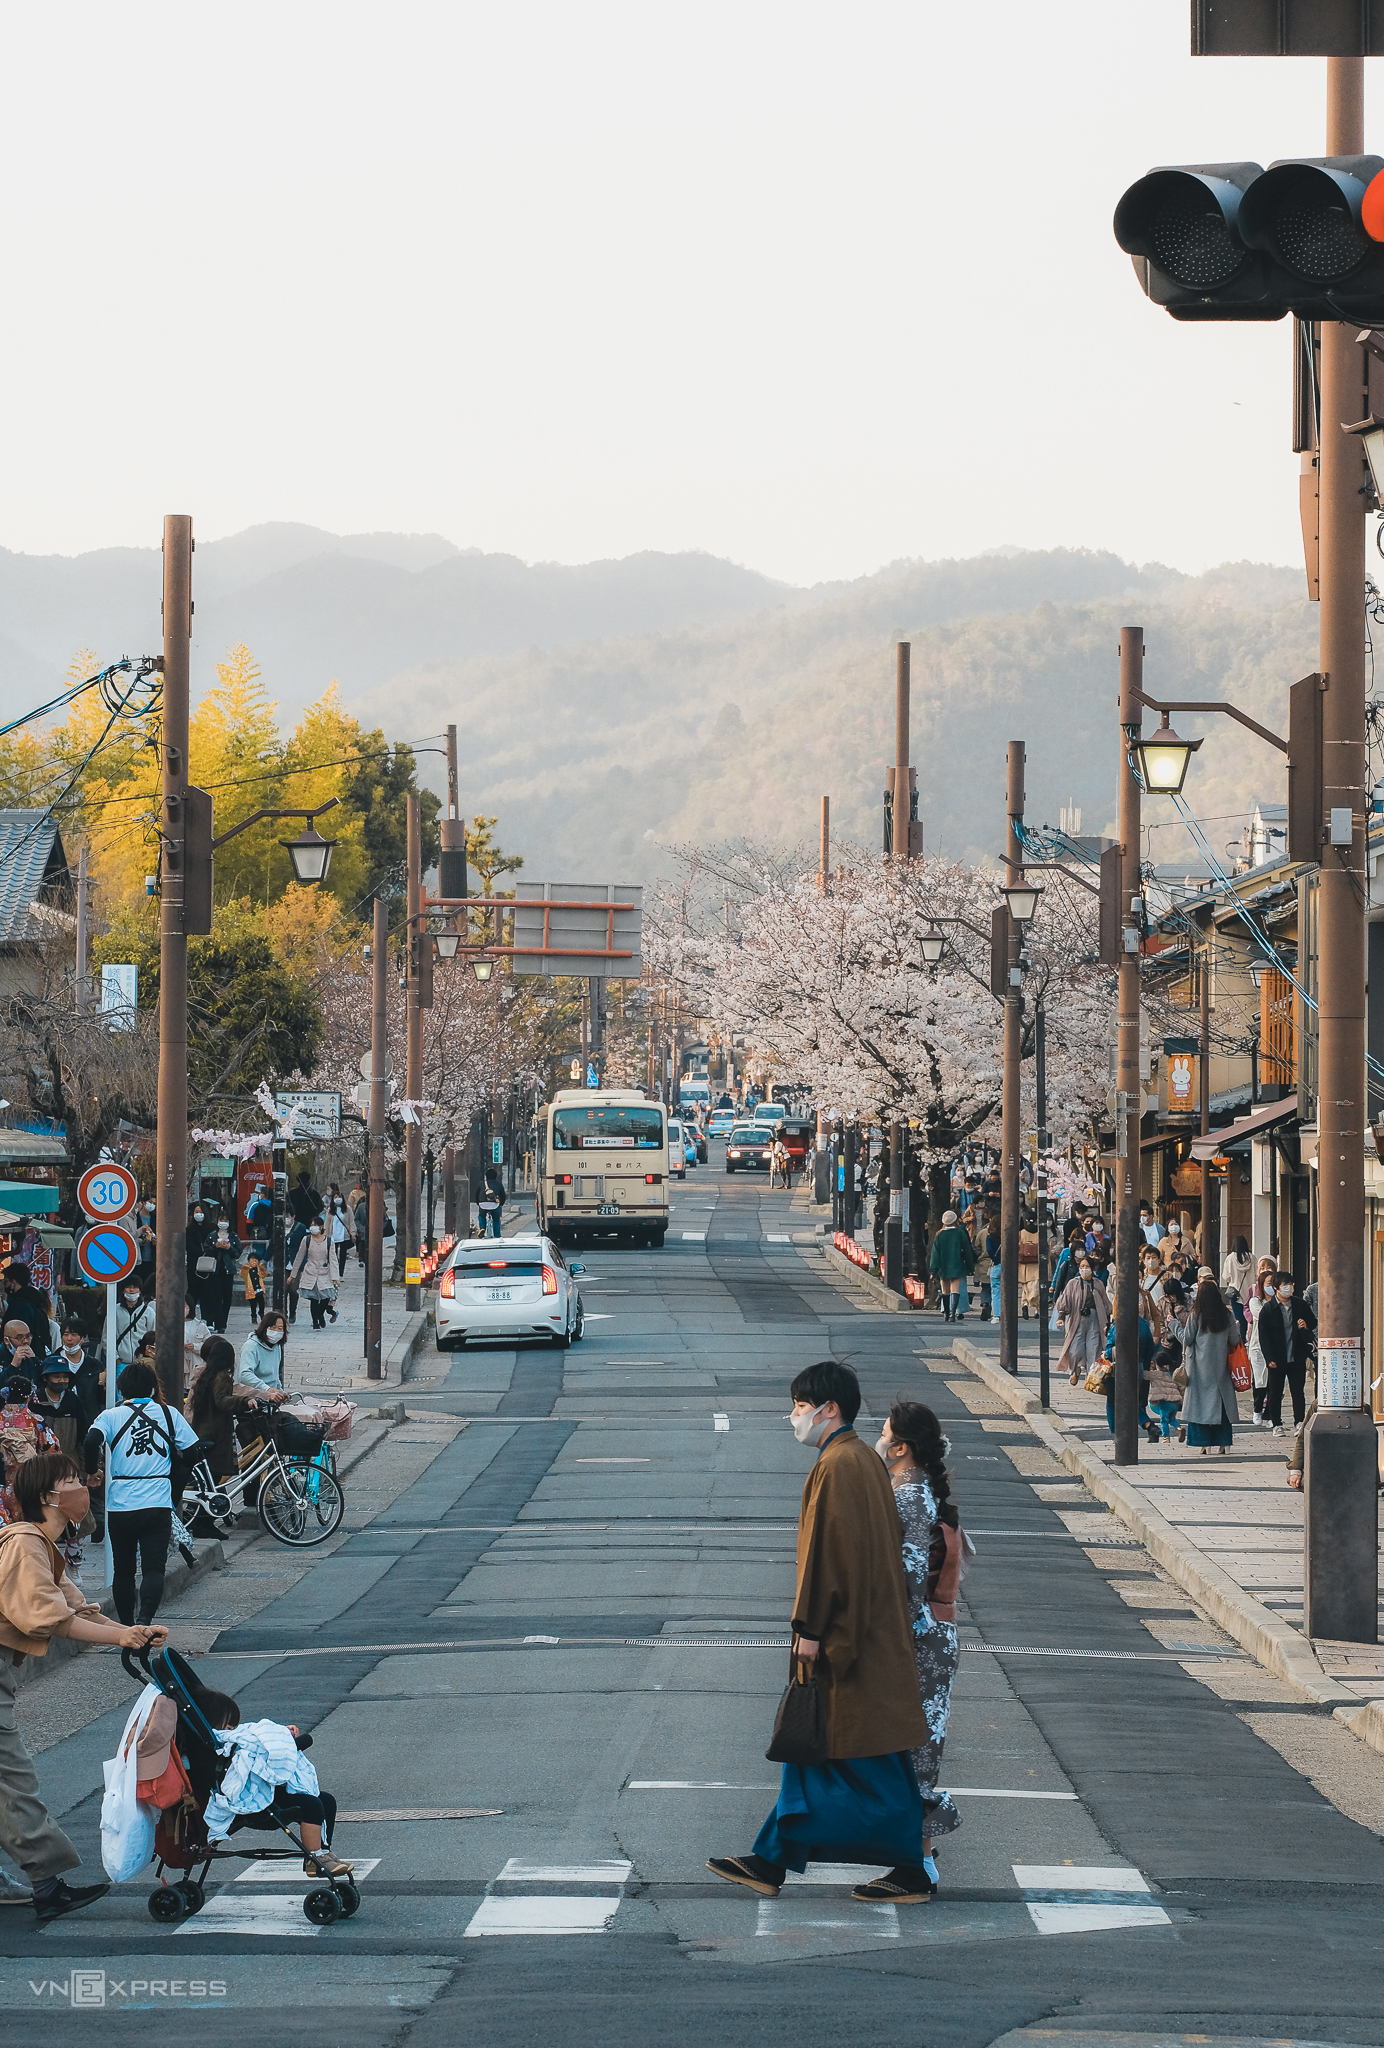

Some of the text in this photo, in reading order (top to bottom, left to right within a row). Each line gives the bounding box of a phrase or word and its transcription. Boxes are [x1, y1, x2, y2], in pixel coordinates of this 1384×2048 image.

[92, 1180, 124, 1206] 30
[33, 1243, 51, 1289] 着物
[1320, 1339, 1356, 1348] 工事予告
[126, 1418, 168, 1458] 嵐
